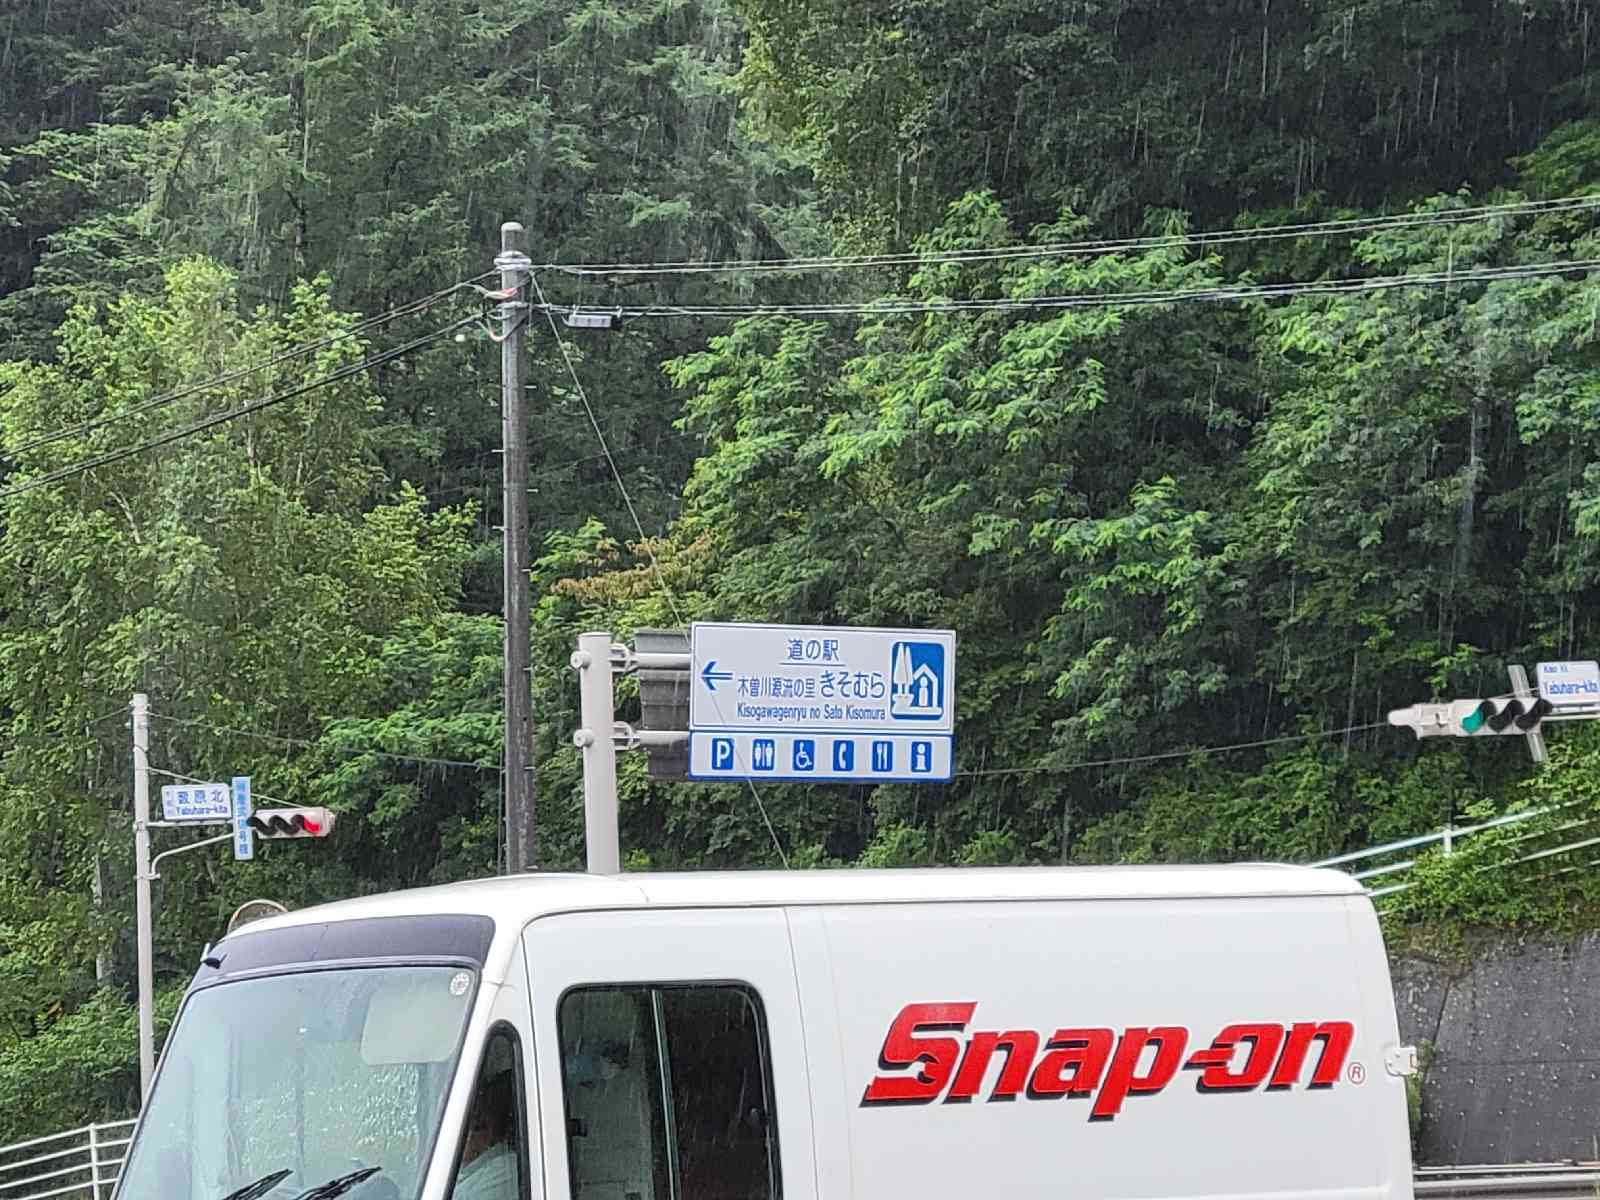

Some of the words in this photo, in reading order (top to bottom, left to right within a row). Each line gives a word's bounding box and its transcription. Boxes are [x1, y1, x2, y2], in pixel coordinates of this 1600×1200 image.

[787, 639, 839, 661] 道の駅
[820, 670, 885, 699] きそむら
[809, 707, 820, 719] no
[824, 704, 842, 720] Sato
[845, 704, 885, 720] Kisomura
[859, 1000, 1355, 1123] Snap-on
